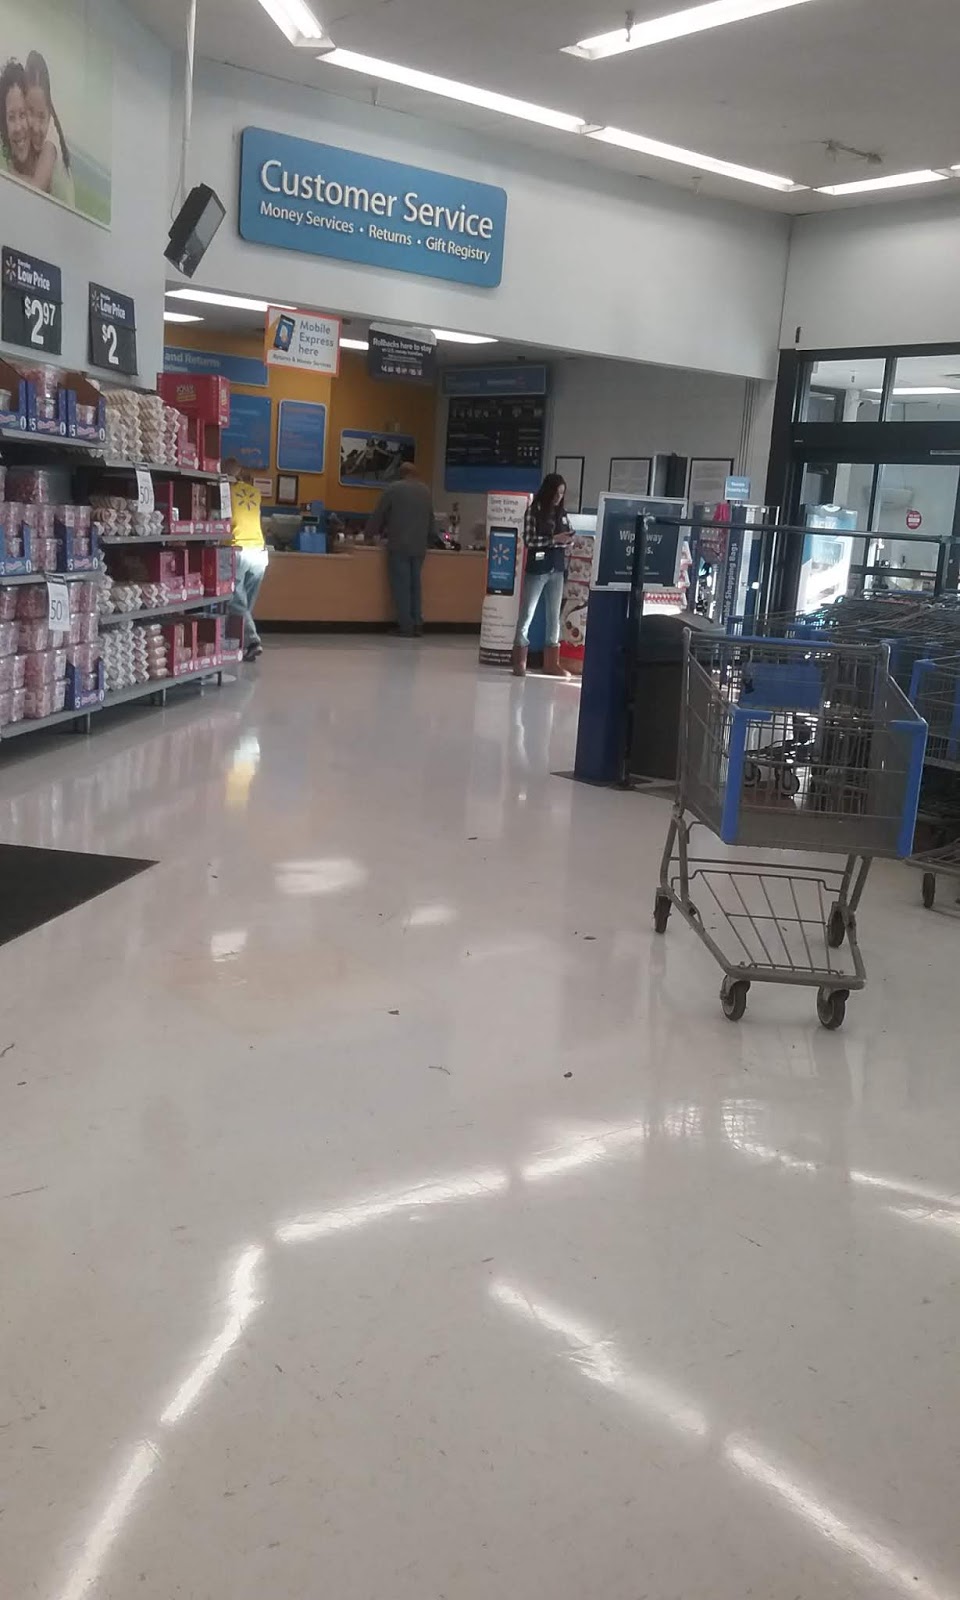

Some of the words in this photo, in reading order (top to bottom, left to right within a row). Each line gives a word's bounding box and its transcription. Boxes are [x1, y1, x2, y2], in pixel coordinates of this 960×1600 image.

[261, 160, 397, 217] Customer
[403, 192, 493, 239] Service
[259, 200, 304, 225] Money
[305, 211, 354, 234] Services
[368, 224, 412, 246] Returns
[425, 236, 446, 252] Gift
[447, 242, 491, 264] Registry
[17, 265, 32, 284] Low
[33, 271, 51, 291] Price
[100, 298, 112, 315] Low
[112, 303, 126, 320] Price
[299, 320, 331, 335] Mobile
[101, 324, 119, 365] $2
[299, 332, 334, 347] Express
[400, 341, 413, 350] here
[413, 343, 420, 351] to
[164, 352, 183, 362] and
[298, 344, 319, 356] here
[620, 530, 637, 543] Wip
[645, 534, 663, 545] way
[729, 543, 738, 562] Bags
[725, 562, 737, 599] Shopping
